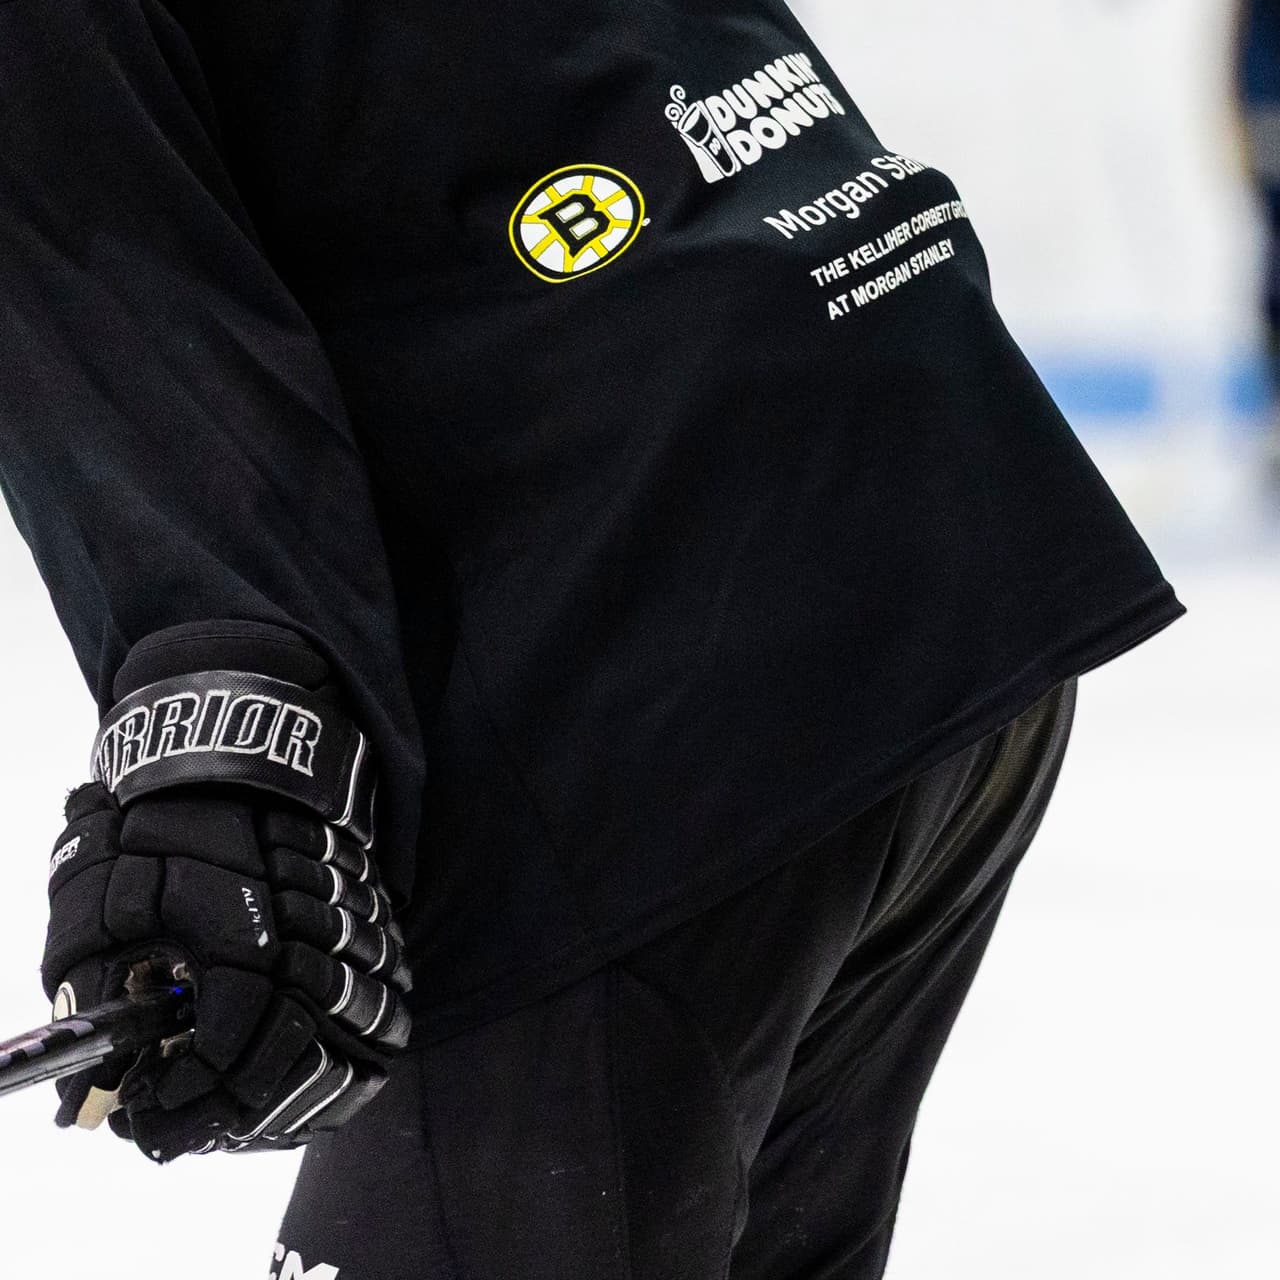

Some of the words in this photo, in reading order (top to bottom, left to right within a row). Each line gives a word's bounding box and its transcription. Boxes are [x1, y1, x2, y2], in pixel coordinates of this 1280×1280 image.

[762, 171, 889, 239] Morgan
[809, 256, 850, 287] THE
[847, 221, 913, 271] KELLIHER
[910, 201, 952, 236] CORBETT
[827, 293, 850, 321] AT
[850, 261, 912, 308] MORGAN
[909, 237, 955, 276] STANLEY
